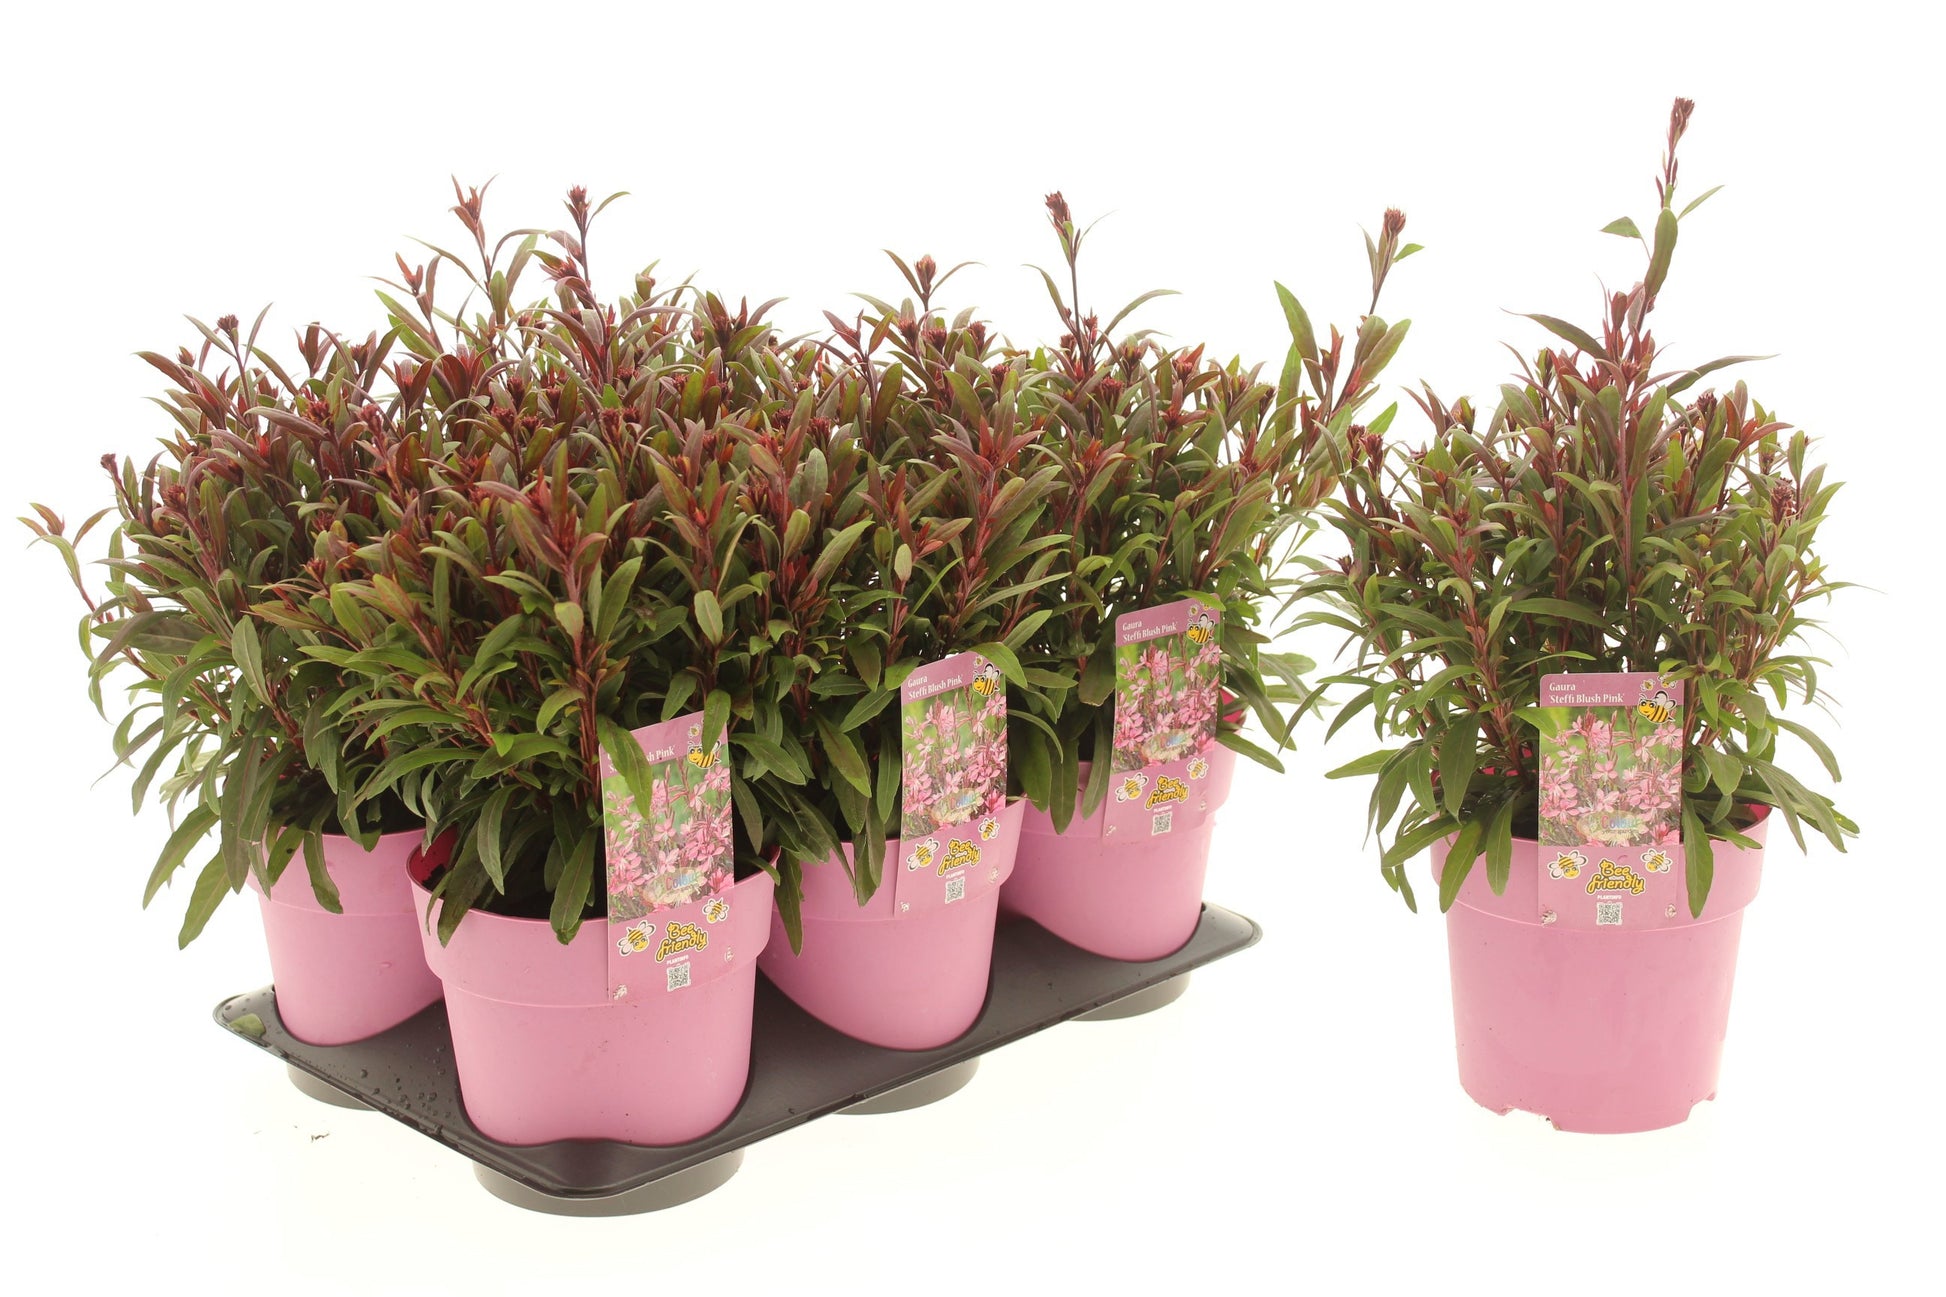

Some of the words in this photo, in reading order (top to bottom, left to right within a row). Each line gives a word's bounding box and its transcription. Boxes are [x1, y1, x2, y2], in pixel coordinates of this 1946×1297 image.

[1122, 620, 1142, 631] Gaura
[1142, 626, 1161, 638] Blush
[907, 675, 928, 688] Gaura
[928, 681, 947, 694] Blush
[1549, 682, 1576, 691] Gaura
[1576, 693, 1601, 703] Blush
[1156, 775, 1180, 791] Bee
[1145, 783, 1189, 810] friendly
[948, 839, 972, 856] Bee
[938, 846, 981, 876] friendly
[1599, 859, 1631, 877] Bee
[1586, 873, 1645, 895] friendly
[666, 921, 696, 940] Bee
[656, 928, 708, 962] friendly
